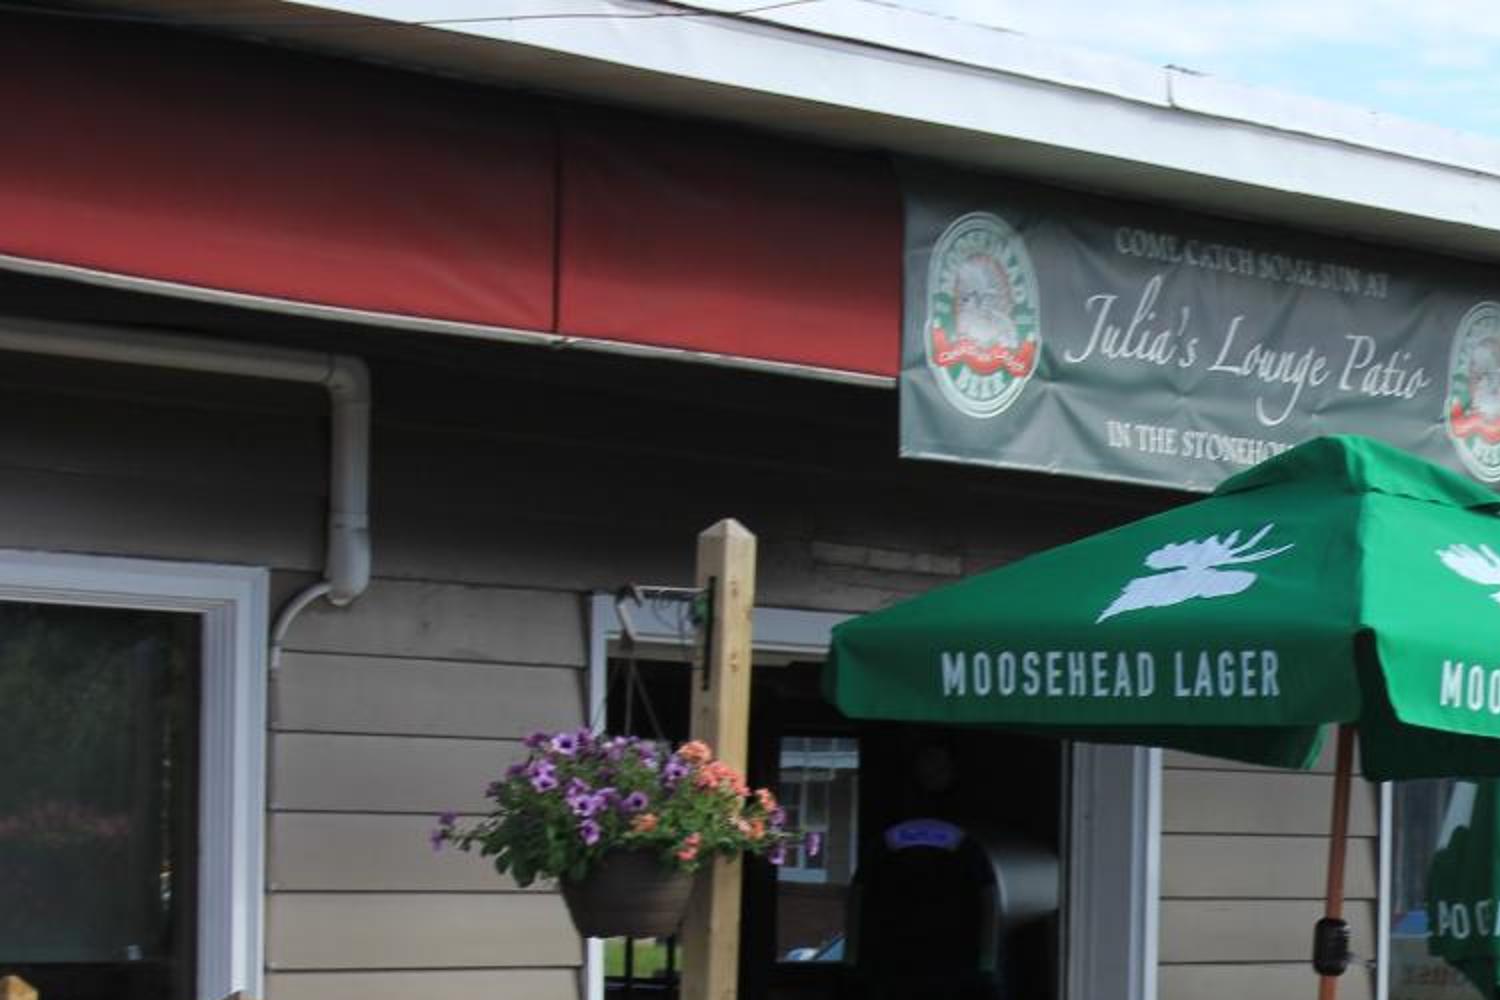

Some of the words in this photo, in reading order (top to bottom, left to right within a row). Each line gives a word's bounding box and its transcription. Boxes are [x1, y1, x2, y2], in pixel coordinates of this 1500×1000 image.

[1183, 239, 1253, 275] CATCH
[1318, 263, 1362, 294] SUN
[1363, 271, 1390, 299] AT
[1064, 274, 1199, 368] Julia's
[1207, 314, 1331, 427] Lounge
[1338, 334, 1432, 399] Patio
[1105, 420, 1131, 449] IN
[1135, 423, 1177, 456] THE
[941, 651, 1155, 697] MOOSEHEAD
[1174, 650, 1280, 697] LAGER
